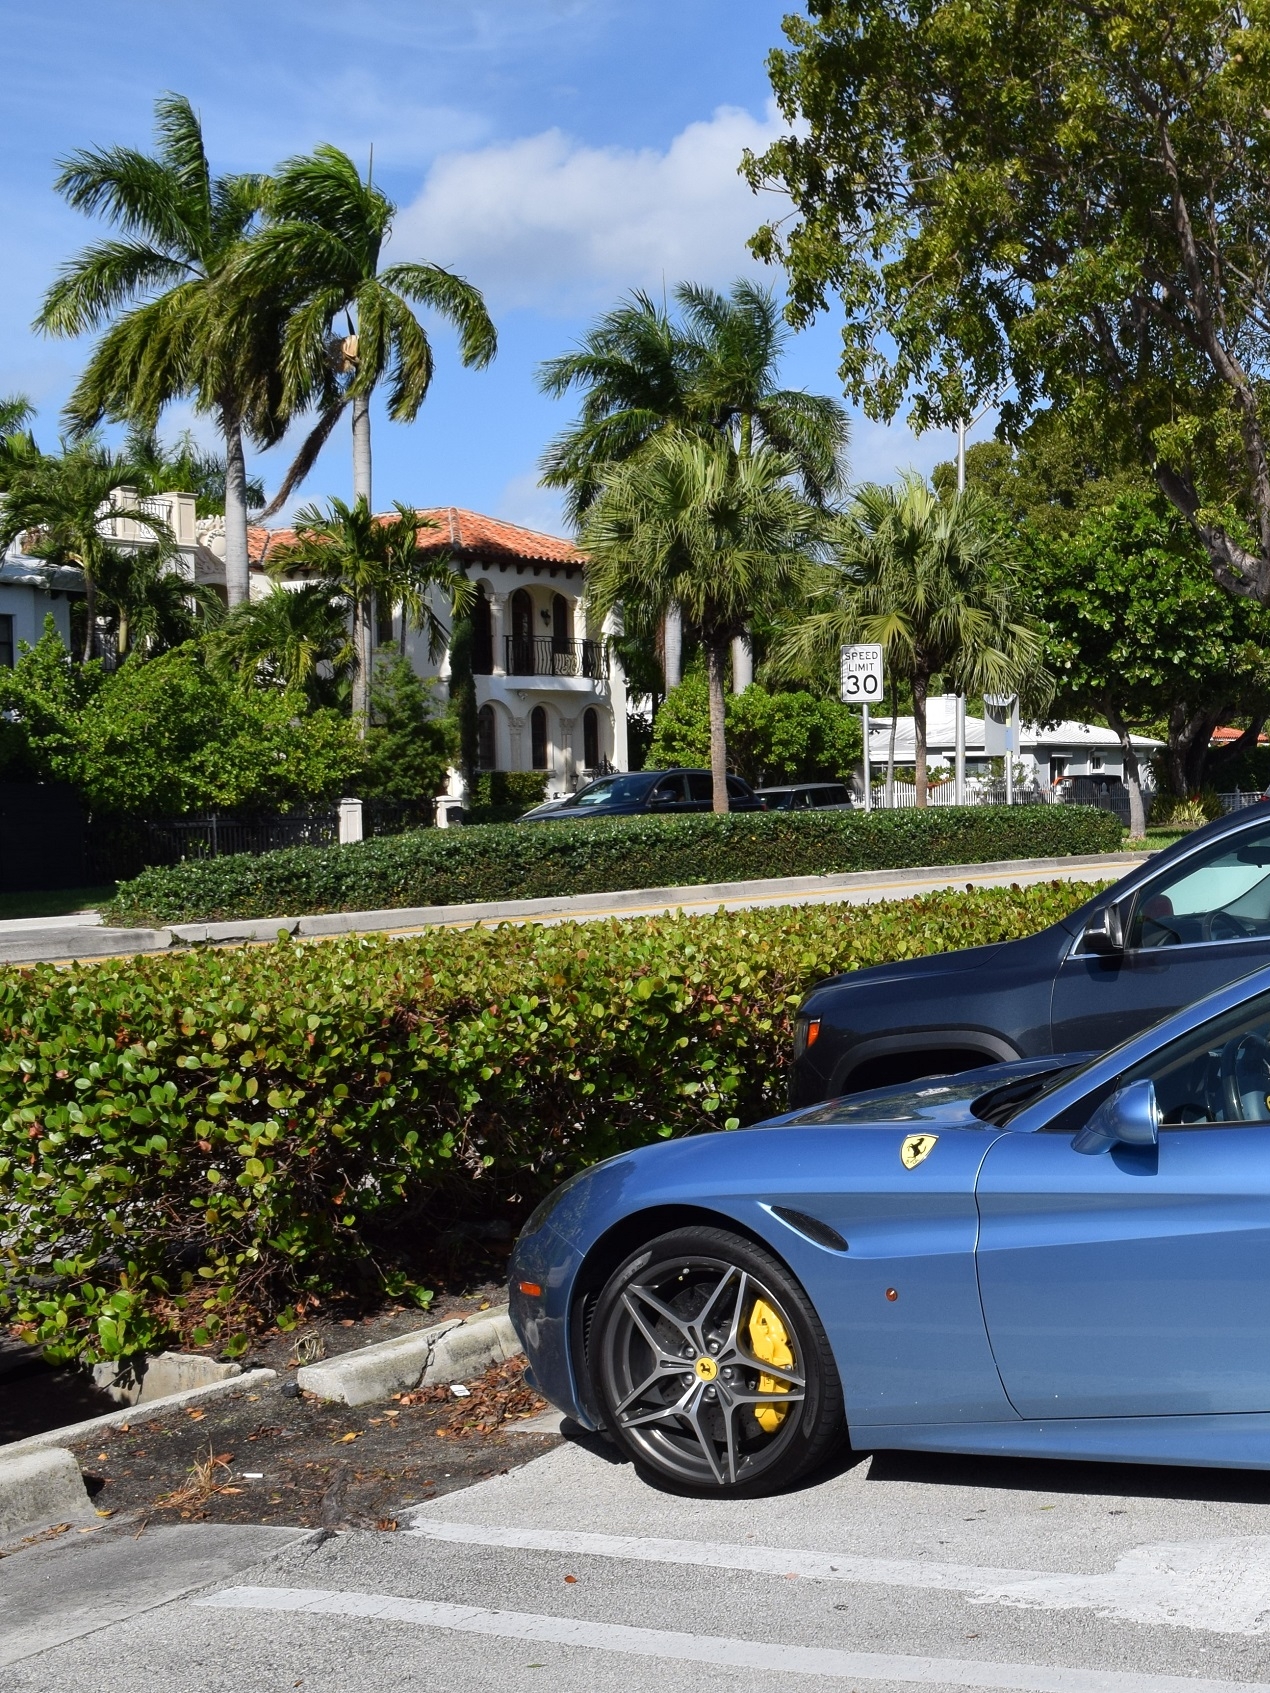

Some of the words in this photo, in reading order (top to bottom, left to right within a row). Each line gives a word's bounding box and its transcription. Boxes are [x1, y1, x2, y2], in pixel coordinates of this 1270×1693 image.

[845, 651, 878, 660] SPEED
[848, 663, 874, 672] LIMIT
[846, 674, 877, 694] 30
